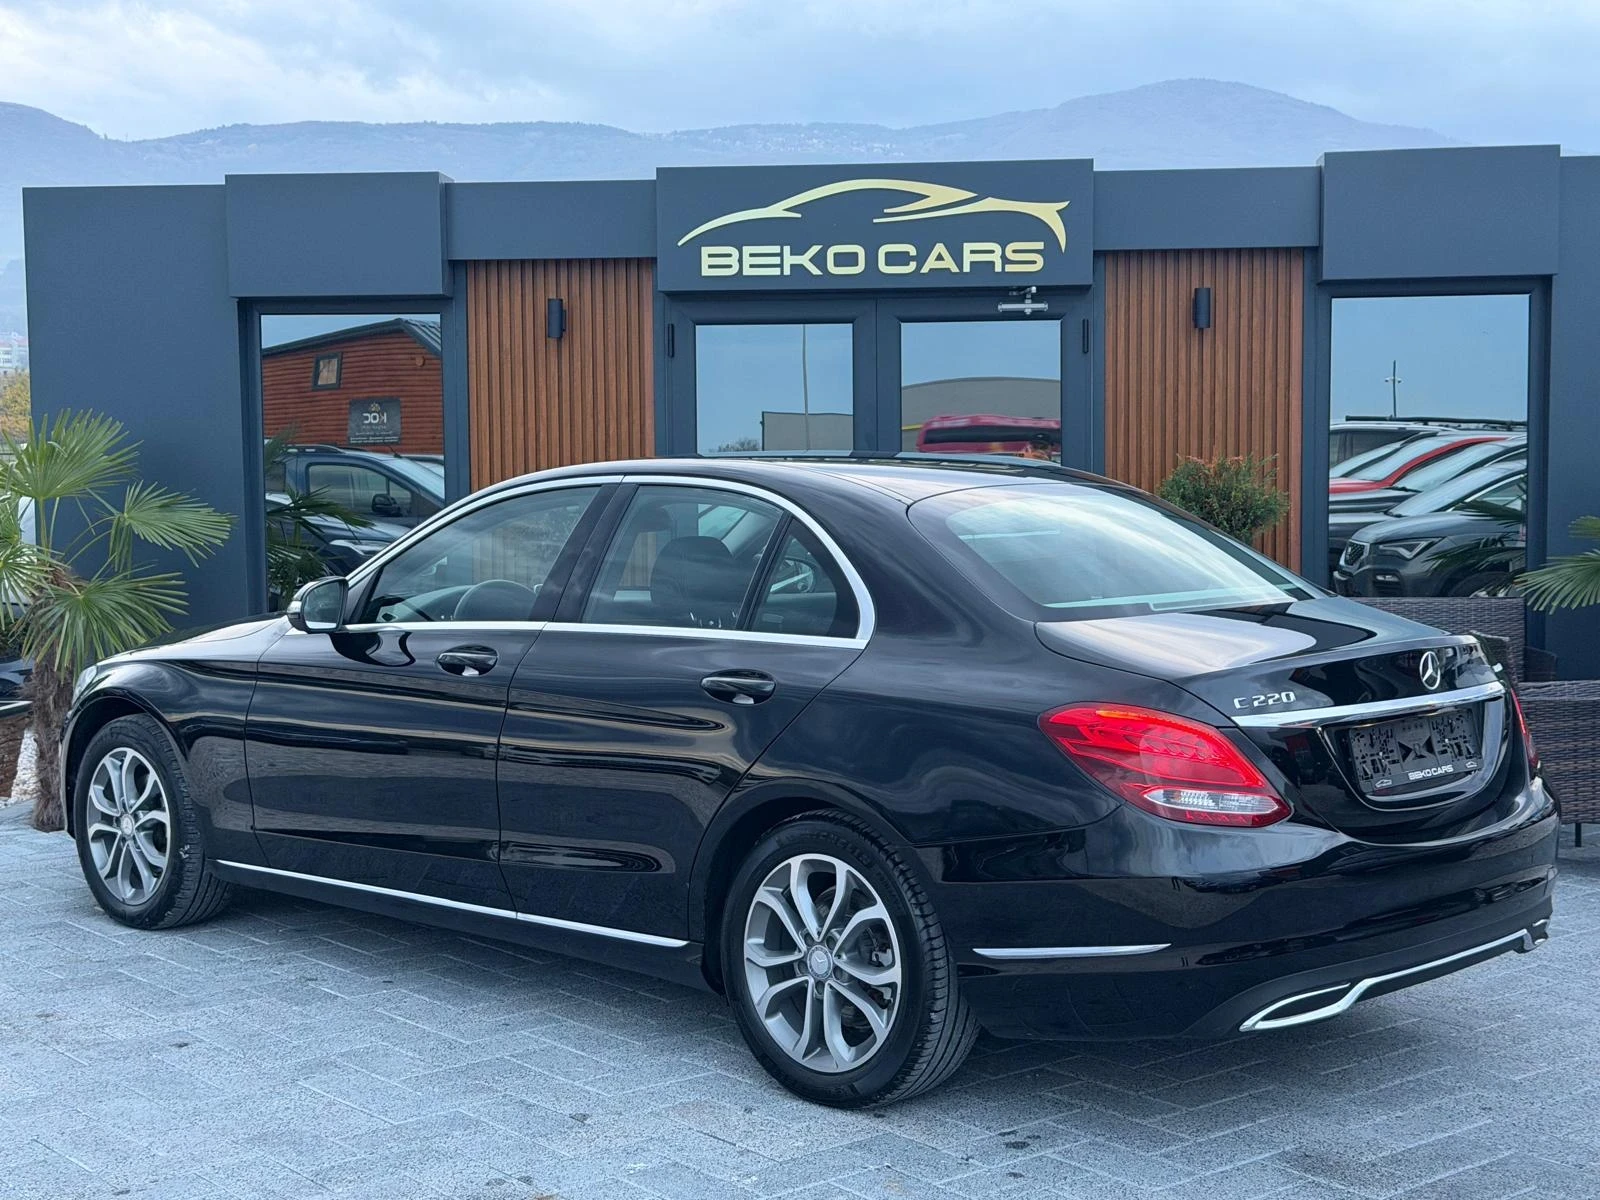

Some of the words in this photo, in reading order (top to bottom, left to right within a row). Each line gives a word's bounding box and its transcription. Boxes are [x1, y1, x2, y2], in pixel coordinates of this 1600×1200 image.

[701, 244, 866, 277] BEKO
[877, 241, 1045, 274] CARS
[1251, 691, 1297, 707] 220
[1408, 769, 1432, 780] BEKO
[1431, 764, 1454, 776] CARS
